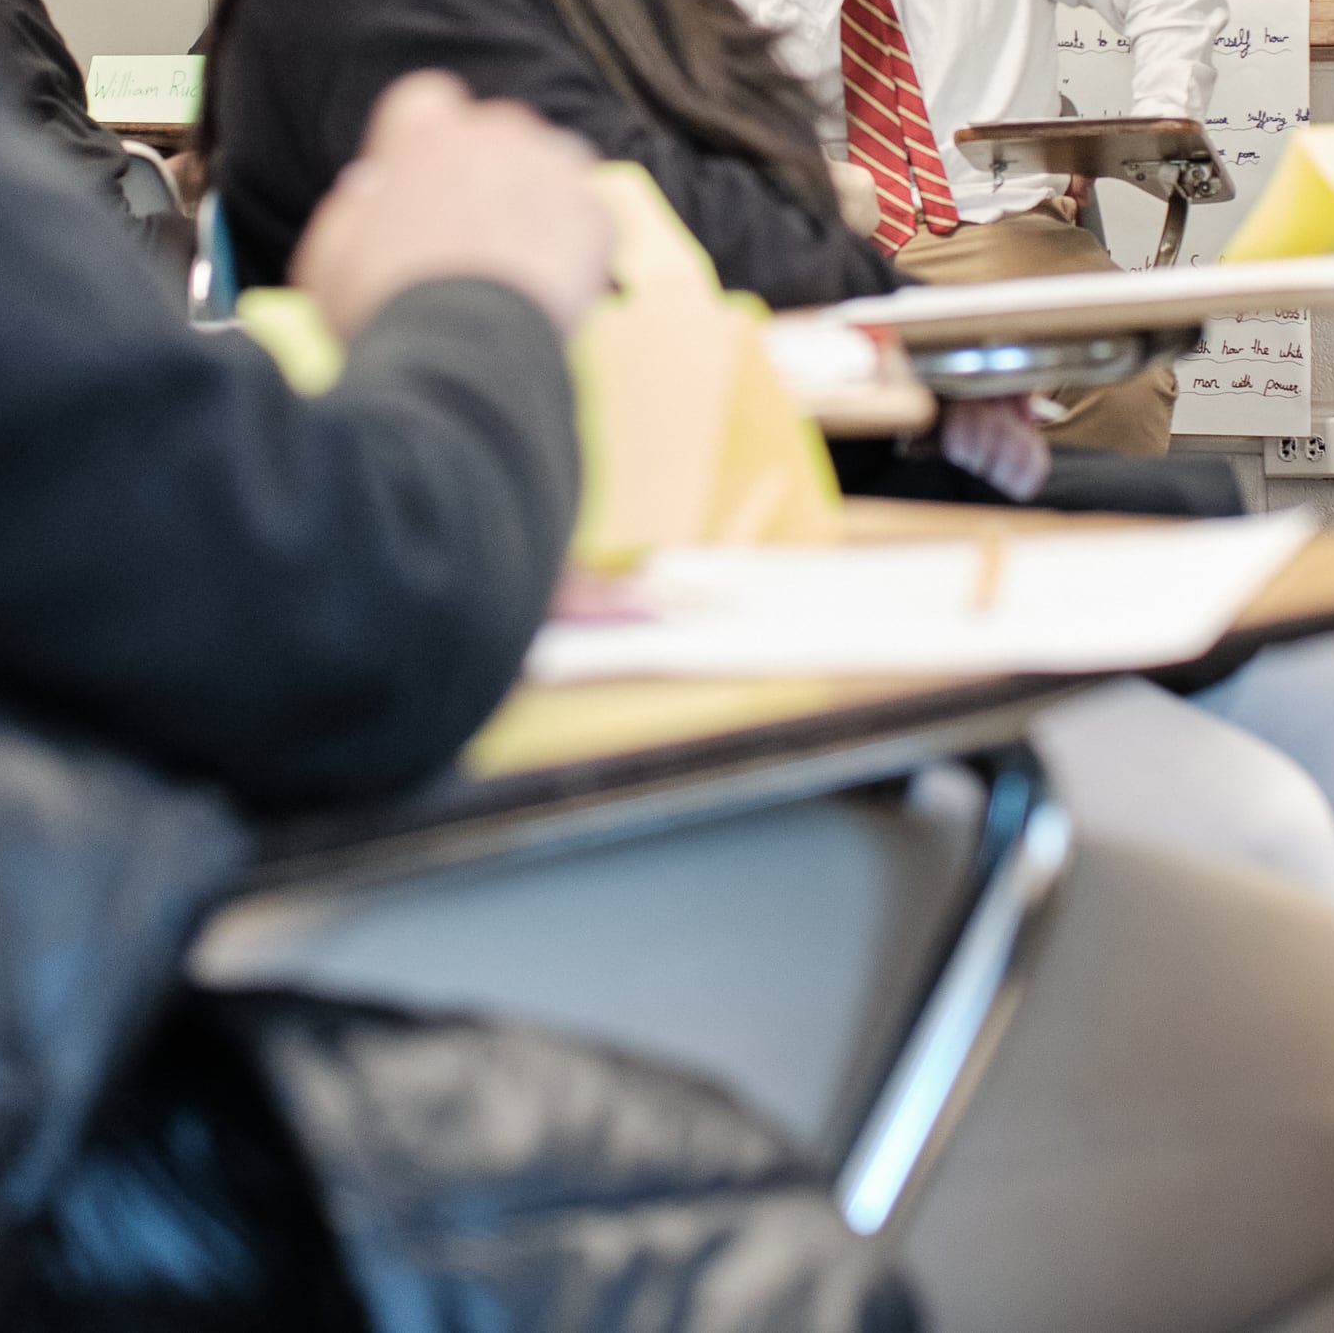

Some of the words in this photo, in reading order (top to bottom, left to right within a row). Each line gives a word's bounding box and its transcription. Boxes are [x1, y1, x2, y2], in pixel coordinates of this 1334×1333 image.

[1264, 27, 1289, 43] how
[1247, 110, 1287, 132] suffering
[1221, 339, 1244, 355] how
[1250, 338, 1270, 355] the
[1278, 342, 1304, 359] white
[1193, 378, 1220, 389] man
[1231, 374, 1253, 389] with
